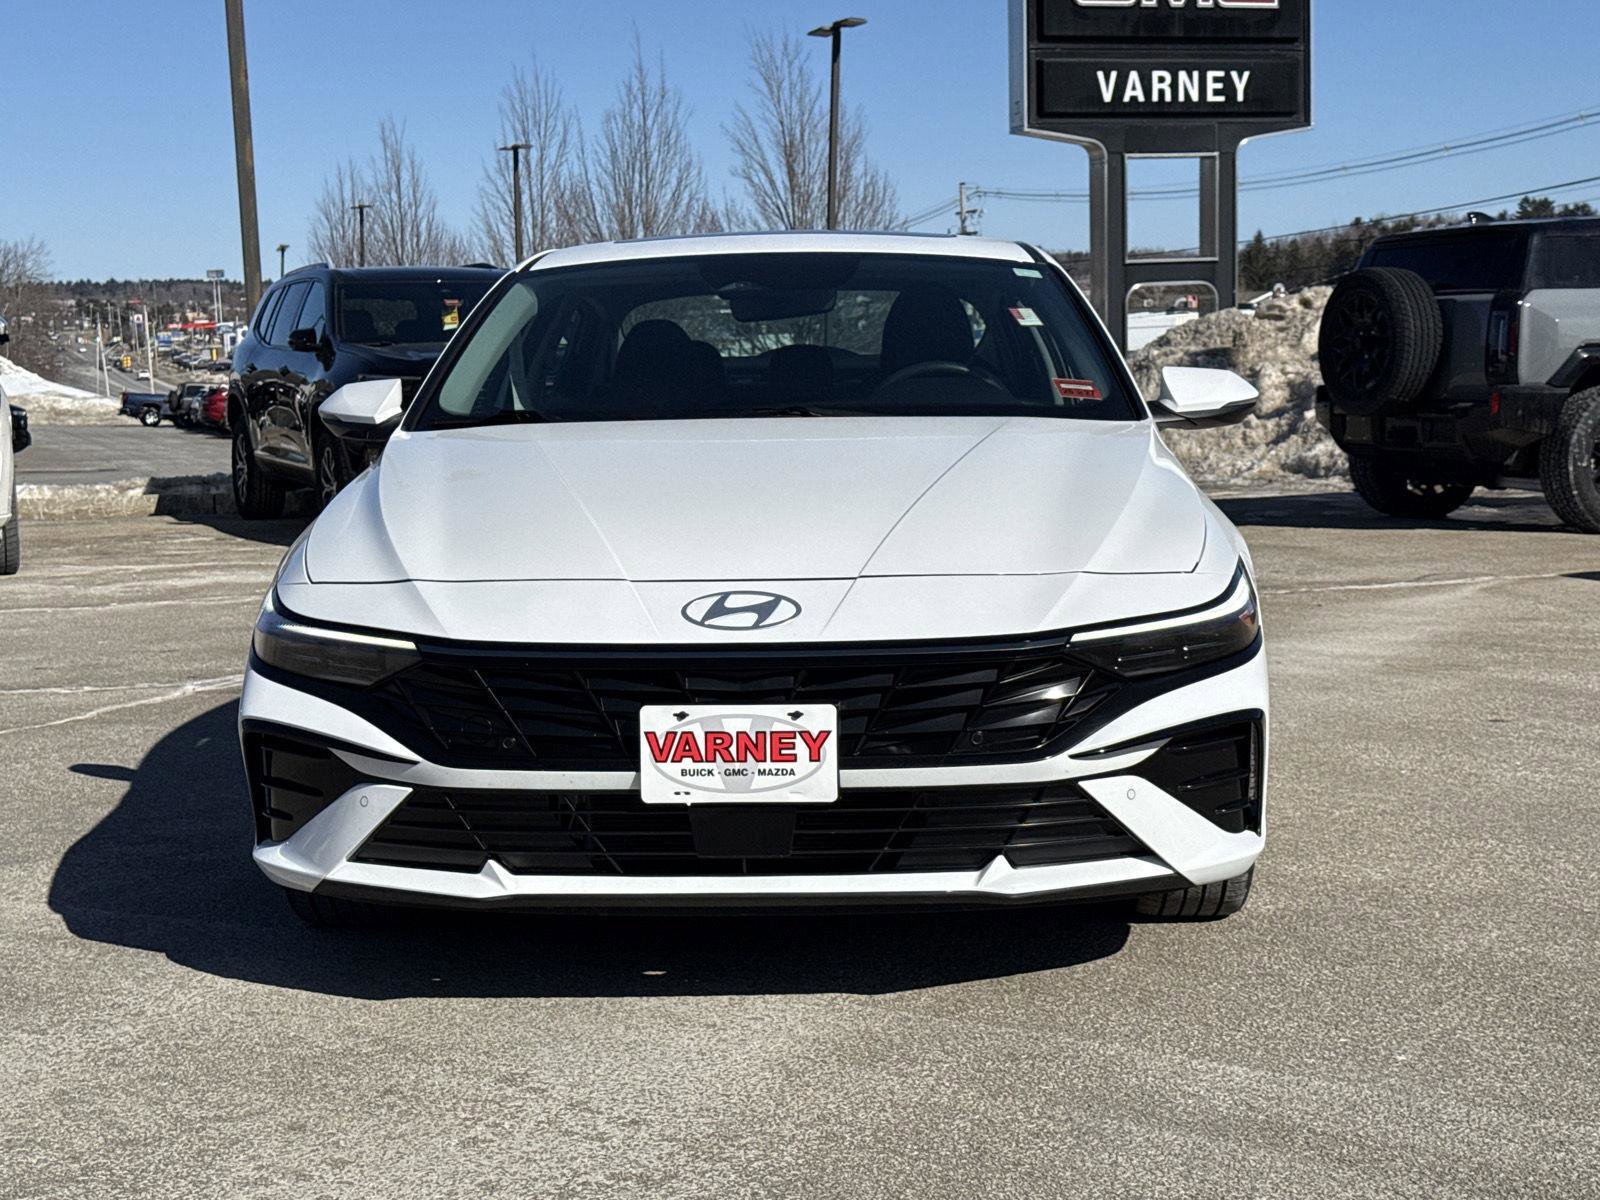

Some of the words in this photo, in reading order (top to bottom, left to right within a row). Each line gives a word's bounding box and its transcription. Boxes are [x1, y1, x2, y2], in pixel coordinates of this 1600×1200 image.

[1096, 70, 1251, 103] VARNEY
[643, 730, 832, 763] VARNEY
[680, 768, 715, 777] BUICK
[724, 768, 749, 777] GMC
[757, 768, 796, 777] MAZDA
